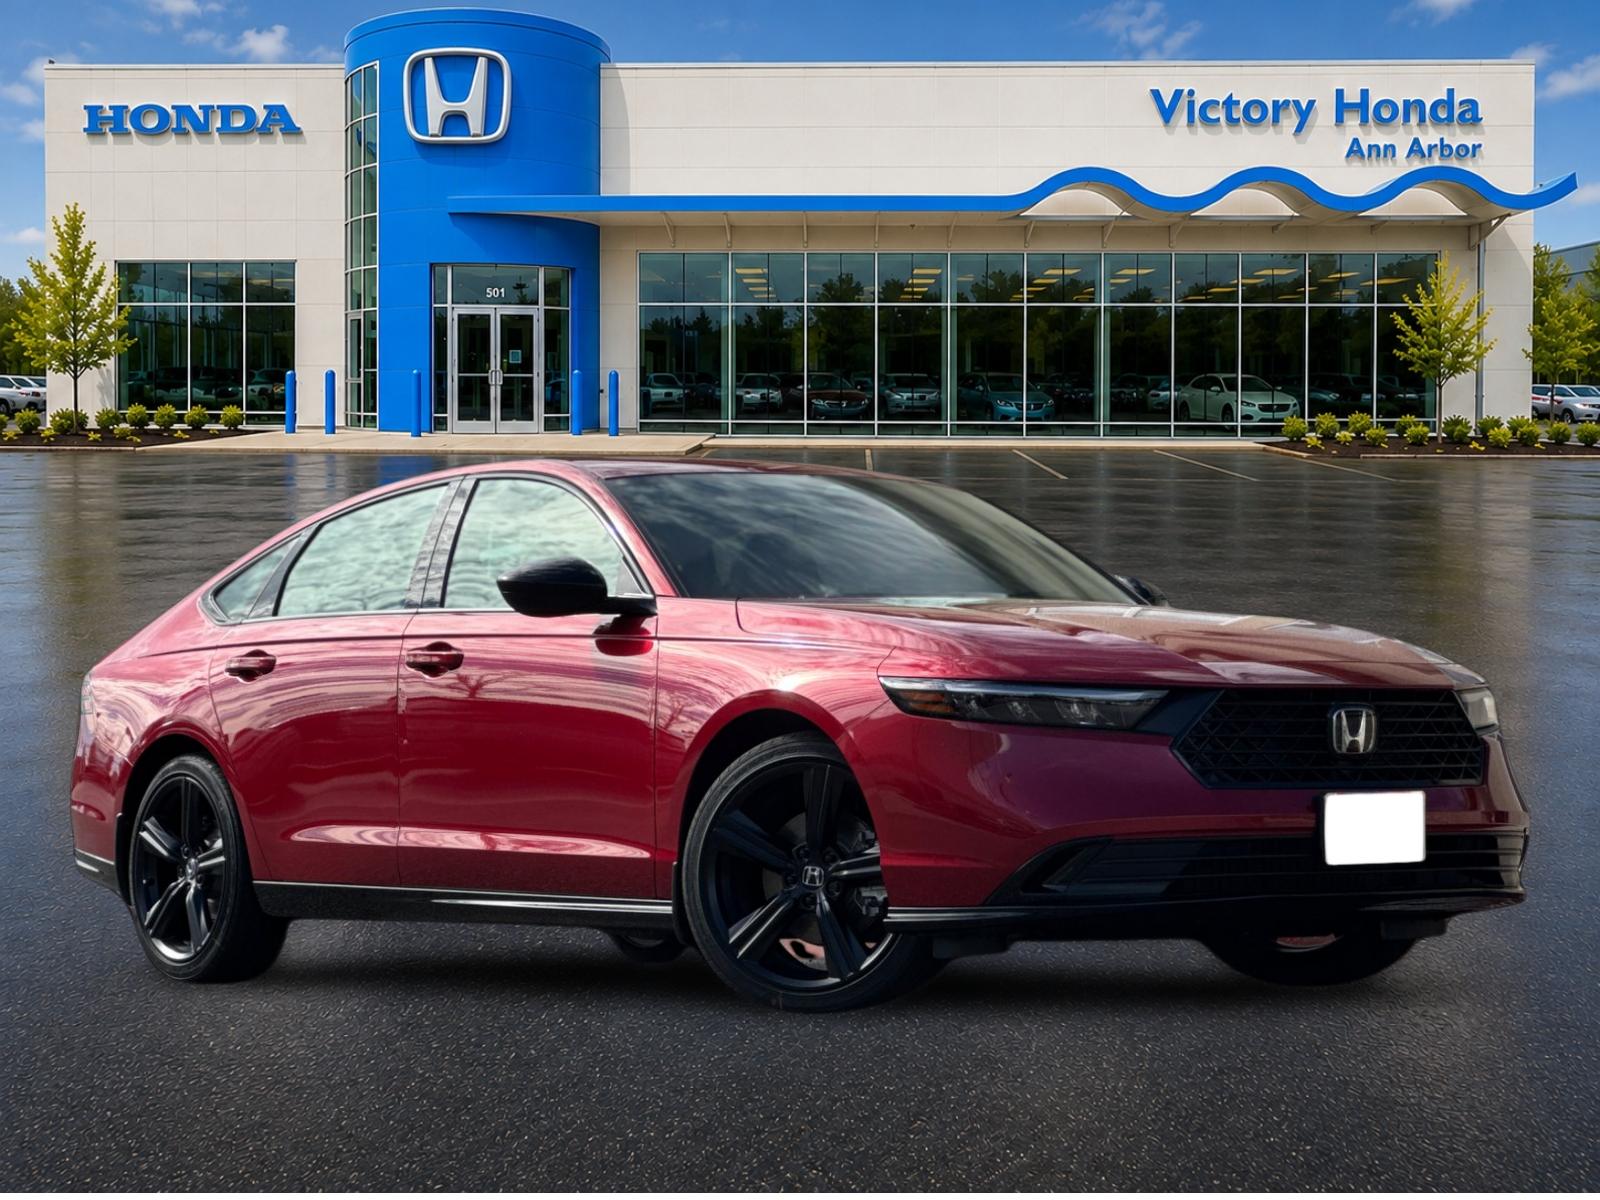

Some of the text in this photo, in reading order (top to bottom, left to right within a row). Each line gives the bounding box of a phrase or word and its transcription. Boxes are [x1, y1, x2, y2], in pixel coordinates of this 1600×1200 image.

[83, 103, 301, 135] HONDA
[1151, 88, 1483, 135] Victory Honda
[1345, 137, 1482, 159] Ann Arbor
[486, 287, 505, 298] 501
